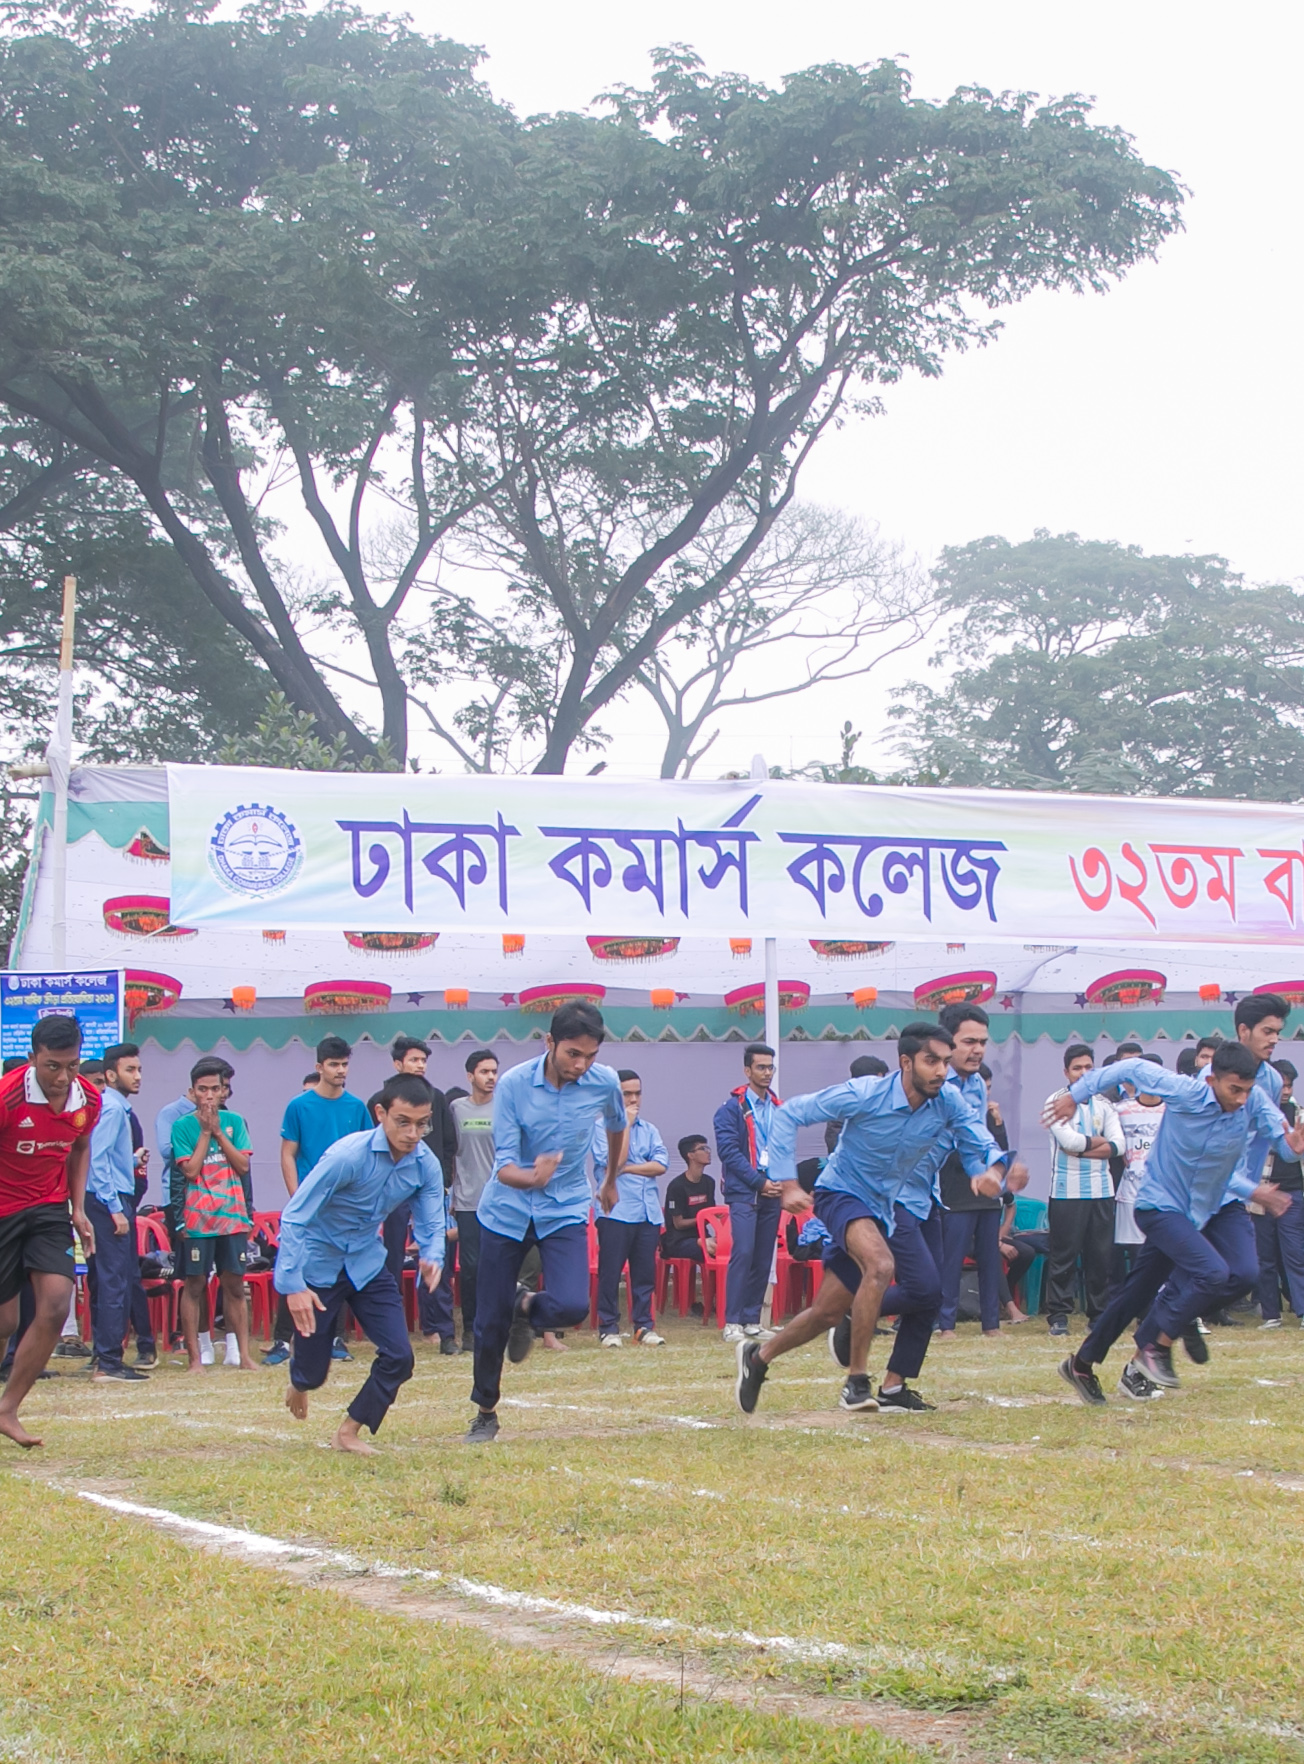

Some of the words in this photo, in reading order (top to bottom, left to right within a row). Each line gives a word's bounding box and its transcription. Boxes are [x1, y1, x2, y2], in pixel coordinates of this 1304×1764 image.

[336, 808, 520, 915] ঢাকা
[538, 794, 762, 917] কমার্স
[778, 833, 1008, 922] কলেজ
[1069, 844, 1241, 926] ৩২তম
[20, 977, 42, 988] ঢাকা
[43, 974, 74, 988] কমার্স
[75, 974, 108, 987] কলেজ
